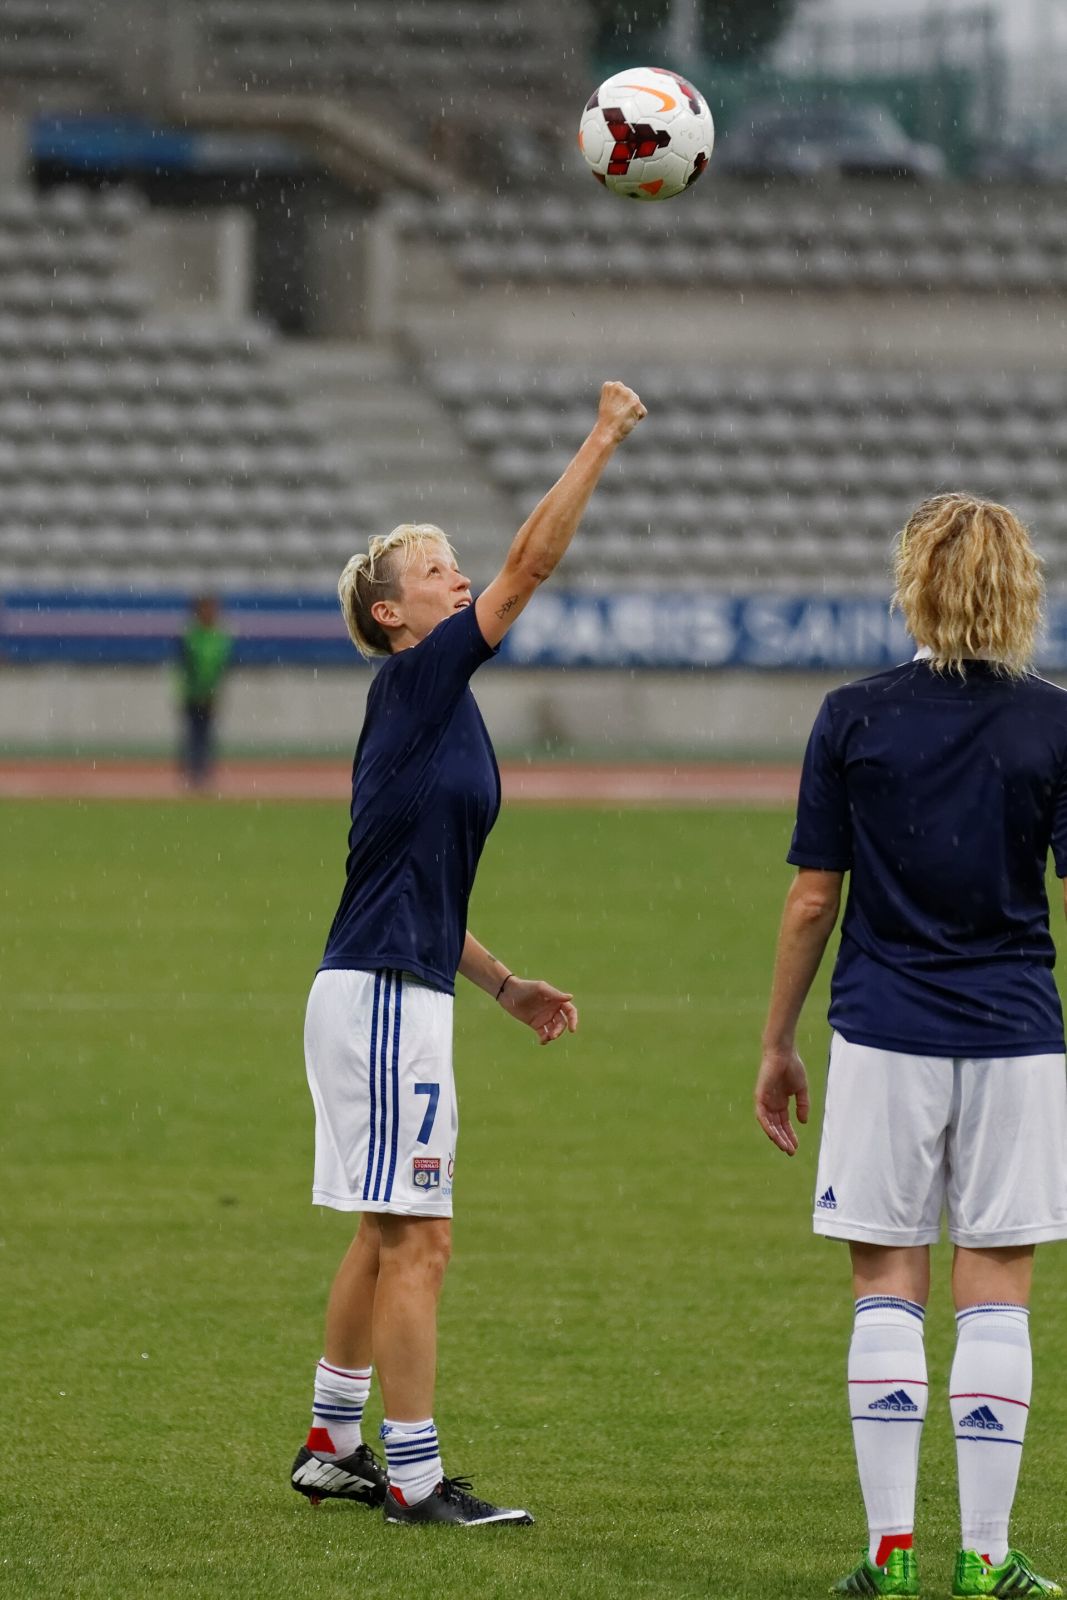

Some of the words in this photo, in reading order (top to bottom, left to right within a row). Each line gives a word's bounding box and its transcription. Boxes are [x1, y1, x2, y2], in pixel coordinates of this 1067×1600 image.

[744, 597, 908, 665] SAIN
[414, 1083, 440, 1145] 7
[868, 1402, 918, 1412] adidas
[959, 1418, 1004, 1432] adidas
